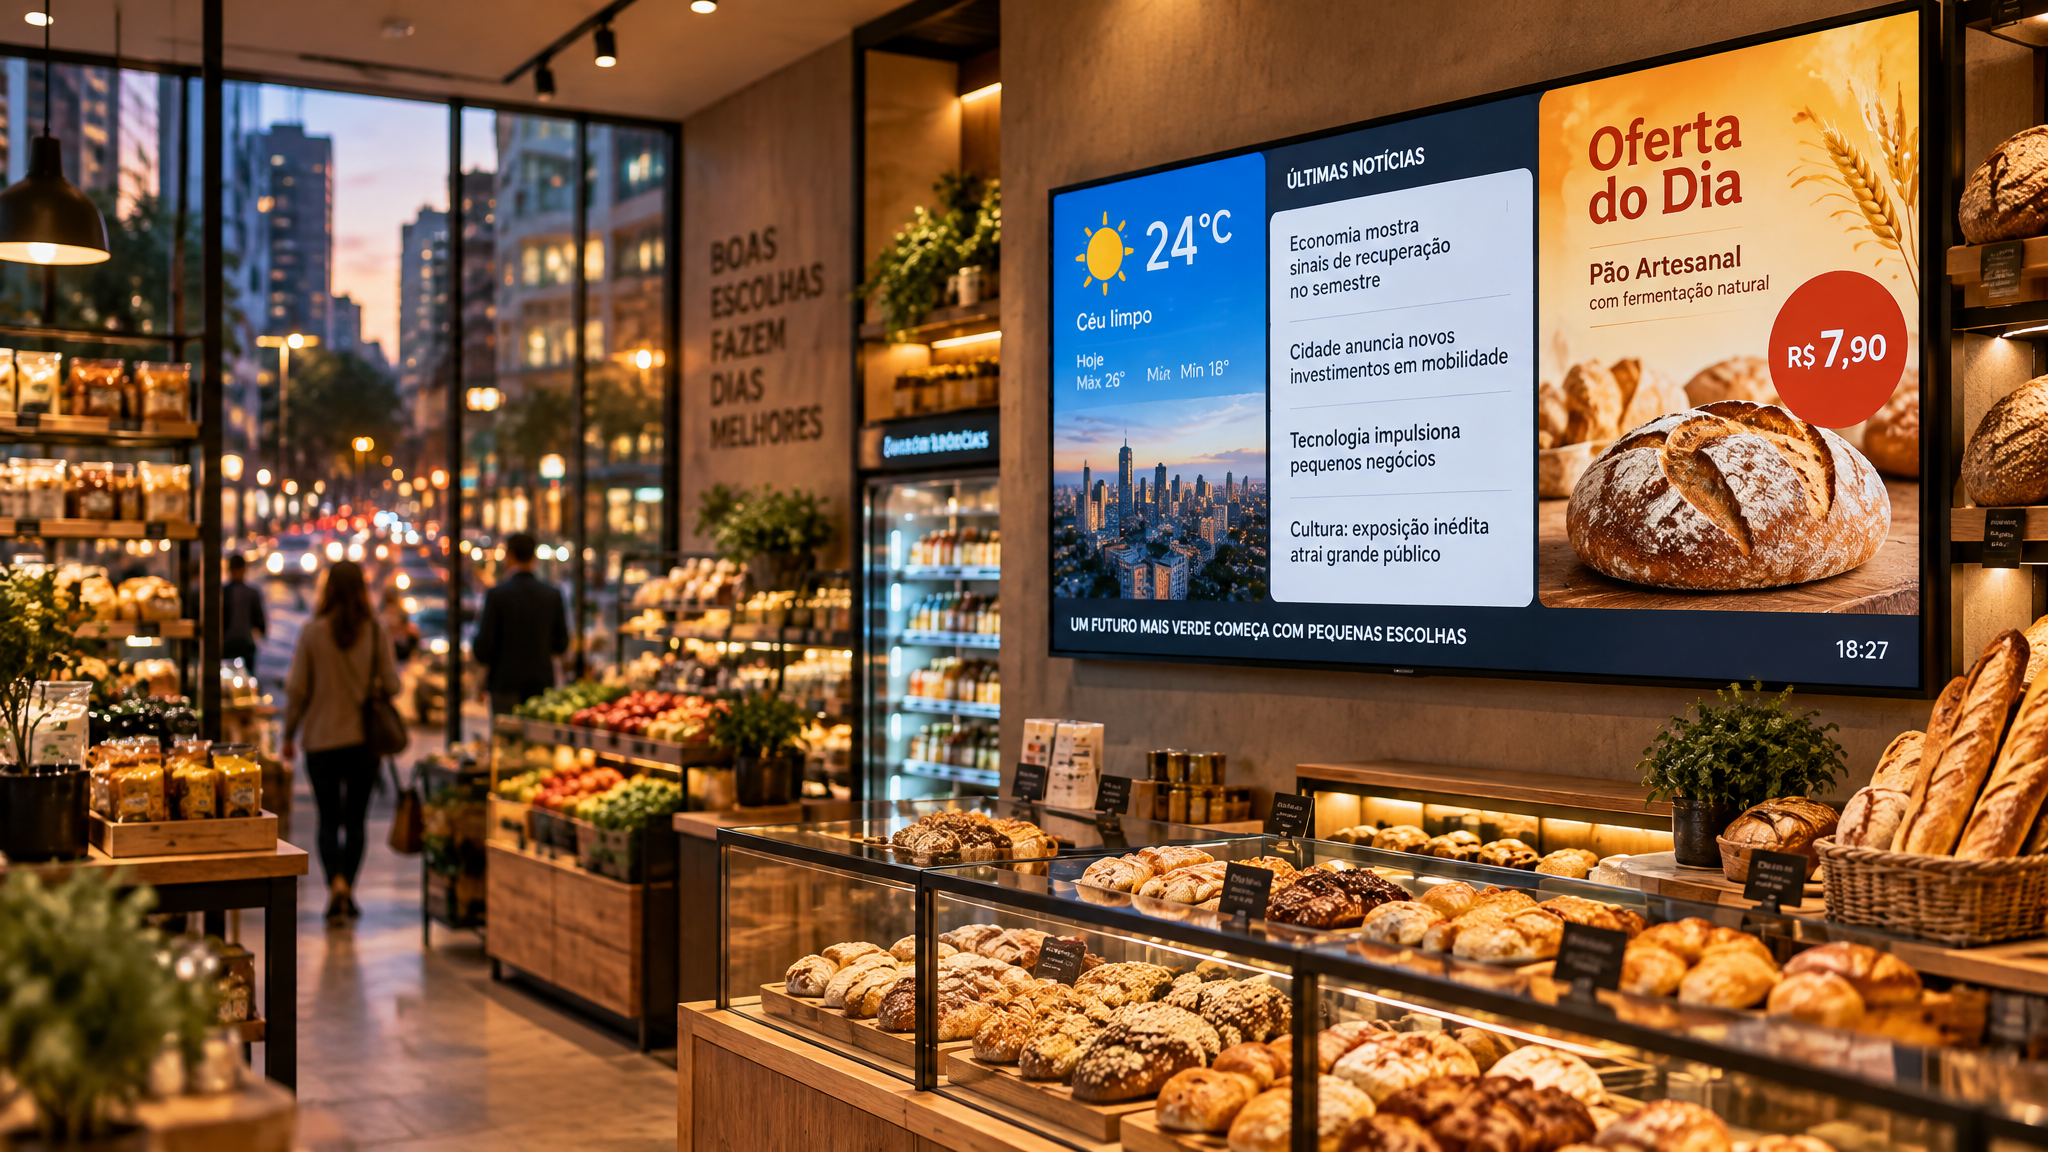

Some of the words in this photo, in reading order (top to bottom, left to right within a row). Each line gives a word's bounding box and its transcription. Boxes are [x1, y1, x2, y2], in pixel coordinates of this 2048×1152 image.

[1588, 111, 1742, 171] Oferta
[1287, 162, 1349, 189] ÚLTIMAS
[1352, 147, 1425, 177] NOTÍCIAS
[1588, 175, 1648, 225] do
[1662, 160, 1743, 215] Dia
[711, 225, 777, 275] BOAS
[1290, 227, 1361, 251] Economia
[1365, 219, 1419, 241] mostra
[1290, 256, 1329, 276] sinais
[1333, 252, 1351, 269] de
[1355, 237, 1451, 266] recuperação
[1589, 261, 1630, 286] Pão
[1635, 244, 1742, 280] Artesanal
[711, 262, 824, 319] ESCOLHAS
[1290, 283, 1309, 299] no
[1312, 274, 1381, 296] semestre
[1589, 294, 1619, 311] com
[1623, 283, 1713, 307] fermentação
[1717, 274, 1770, 297] natural
[1076, 312, 1106, 331] Céu
[1110, 309, 1152, 330] limpo
[711, 316, 786, 364] FAZEM
[1290, 340, 1341, 360] Cidade
[1345, 333, 1404, 357] anuncia
[1408, 330, 1456, 350] novos
[1787, 342, 1816, 370] R$
[1820, 329, 1887, 370] 7,90
[1076, 352, 1104, 370] Hoje
[1105, 371, 1126, 388] 26°
[1290, 362, 1390, 384] investimentos
[1394, 359, 1417, 375] em
[1422, 347, 1509, 372] mobilidade
[710, 367, 764, 408] DIAS
[710, 403, 824, 449] MELHORES
[1290, 427, 1370, 449] Tecnologia
[1375, 423, 1461, 447] impulsiona
[1290, 457, 1362, 477] pequenos
[1366, 450, 1436, 473] negócios
[1290, 520, 1349, 538] Cultura:
[1352, 518, 1429, 540] exposição
[1434, 517, 1489, 536] inédita
[1290, 545, 1323, 563] atrai
[1327, 546, 1379, 566] grande
[1383, 544, 1441, 566] público
[1070, 617, 1089, 632] UM
[1091, 618, 1138, 633] FUTURO
[1140, 619, 1169, 634] MAIS
[1172, 620, 1211, 636] VERDE
[1214, 621, 1270, 641] COMEÇA
[1272, 623, 1304, 639] COM
[1308, 624, 1383, 642] PEQUENAS
[1386, 626, 1467, 645] ESCOLHAS
[1836, 640, 1889, 660] 18:27
